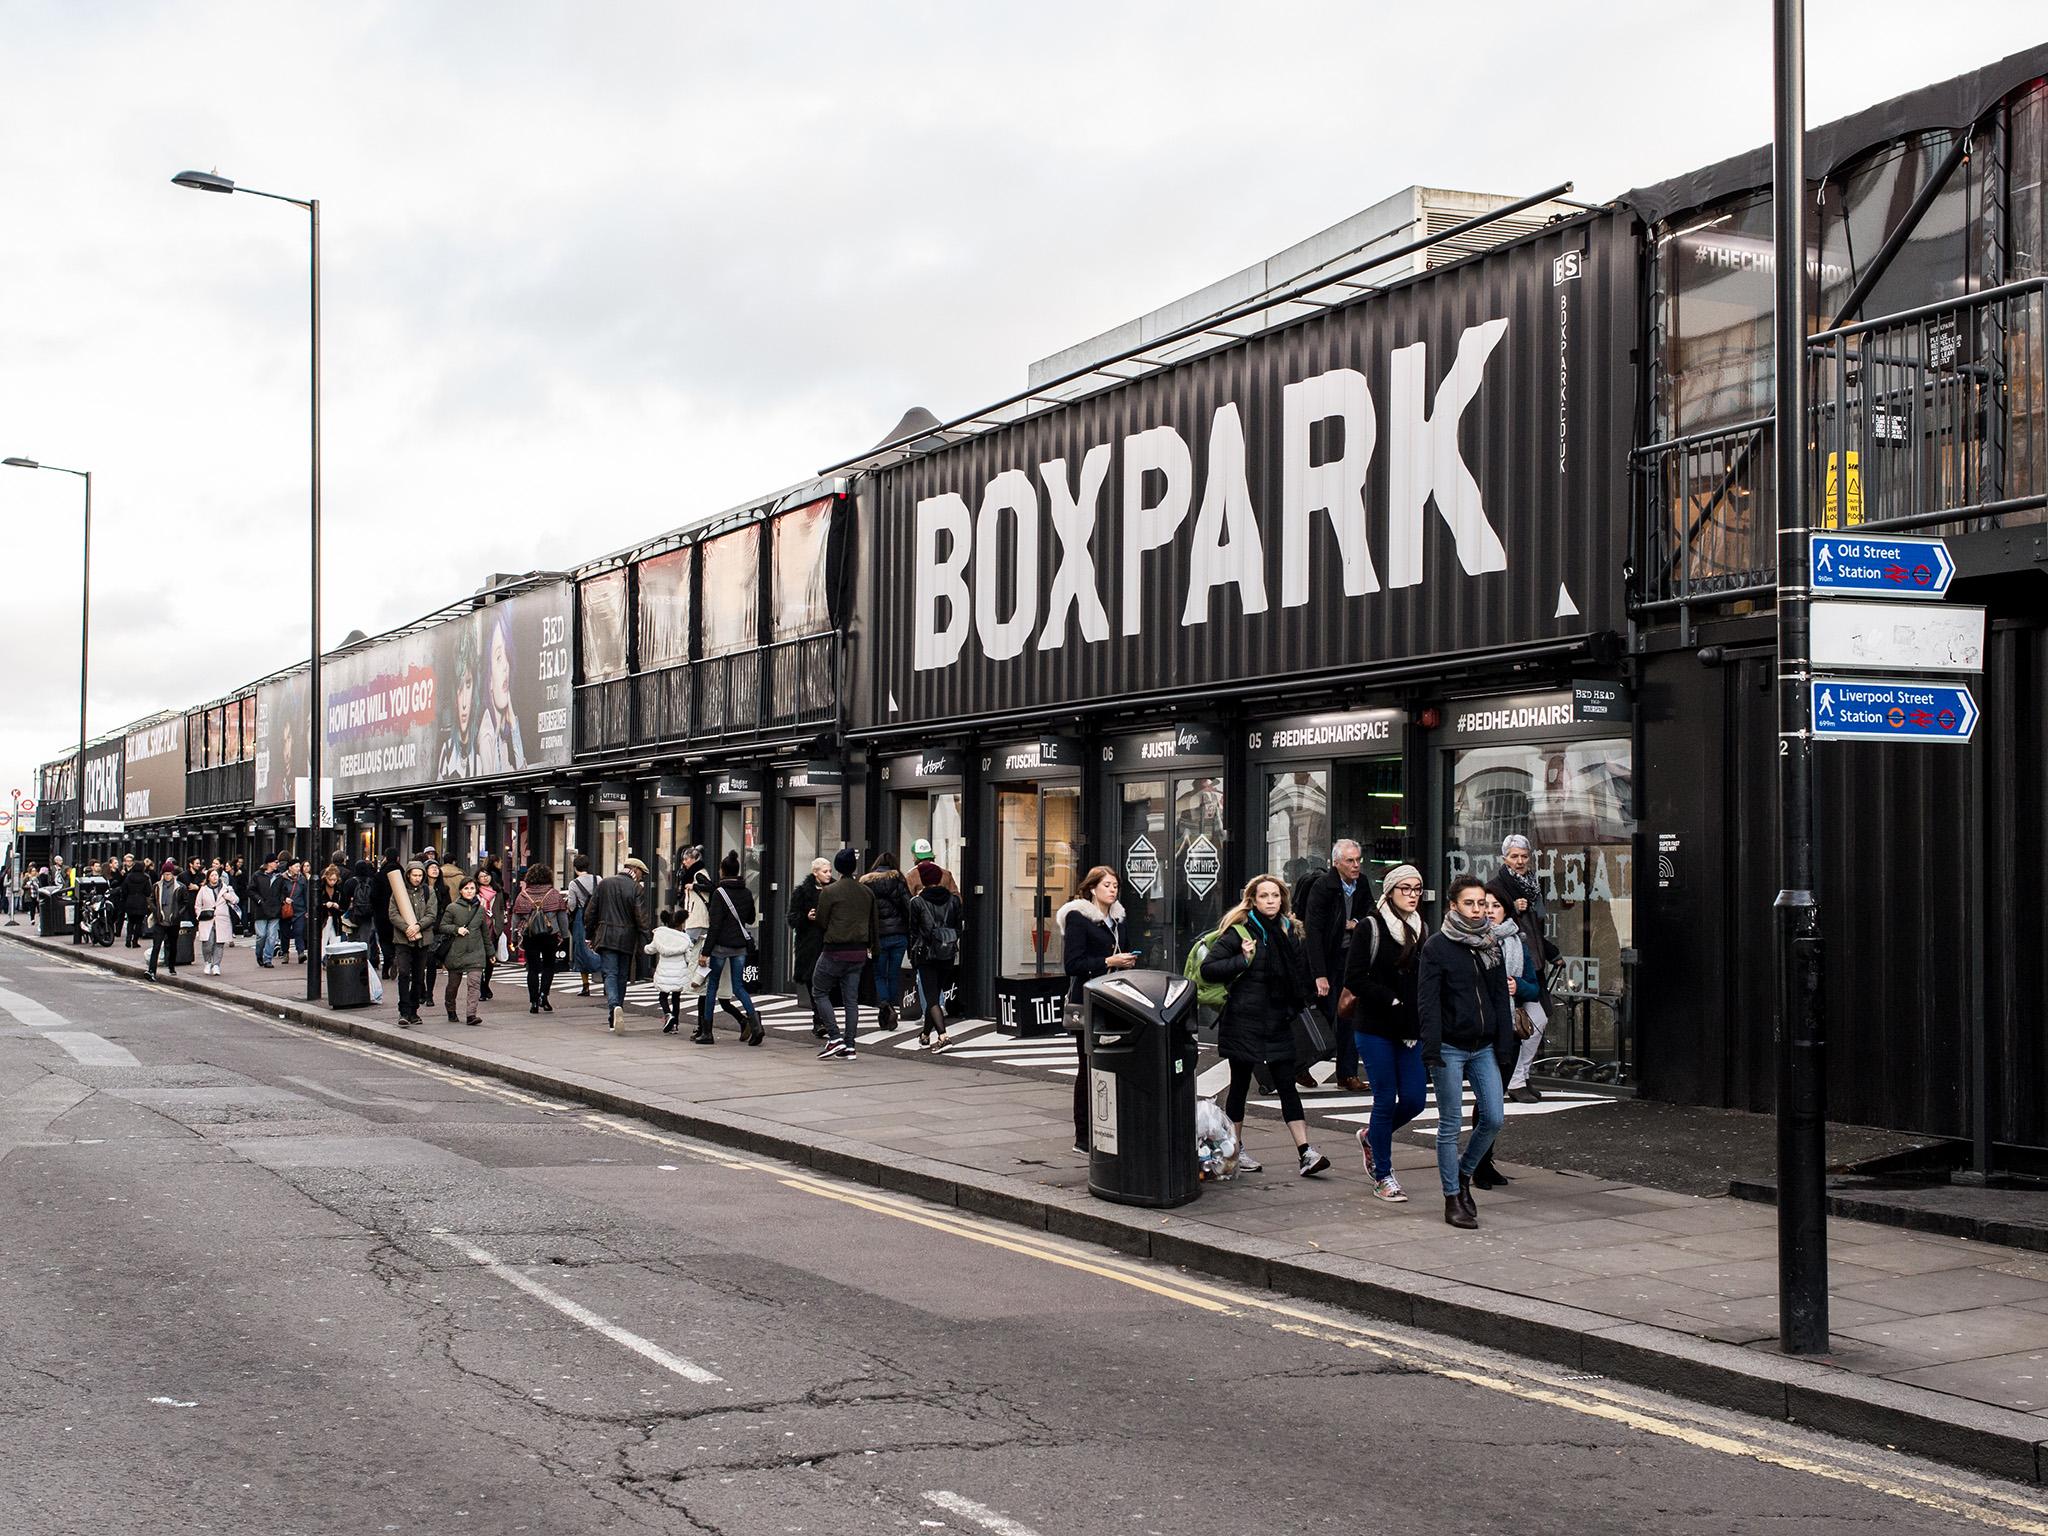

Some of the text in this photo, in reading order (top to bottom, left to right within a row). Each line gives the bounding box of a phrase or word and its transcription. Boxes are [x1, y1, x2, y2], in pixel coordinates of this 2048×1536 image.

[914, 317, 1510, 671] BOXPARK
[1838, 544, 1900, 560] Old Street
[1838, 564, 1881, 579] Station
[542, 616, 565, 648] BED
[538, 648, 568, 681] HEAD
[1575, 689, 1615, 700] BED HEAD
[1839, 689, 1934, 705] Liverpool Street
[329, 679, 433, 733] HOW FAR WILL YOU GO?
[1457, 704, 1594, 732] #BEDHEADHAIRS
[1840, 710, 1883, 723] Station
[1249, 733, 1262, 749] 05
[1272, 721, 1389, 748] #BEDHEADHAIRSPACE
[1102, 746, 1113, 761] 06
[1142, 740, 1179, 758] #JUSTH
[1780, 741, 1788, 755] 2
[340, 743, 416, 778] REBELLIOUS COLOUR
[982, 757, 991, 771] 07
[881, 767, 890, 780] 08
[84, 752, 120, 814] OXPARK
[1130, 859, 1154, 872] JUST HYPE
[1189, 859, 1215, 872] JUST HYPE
